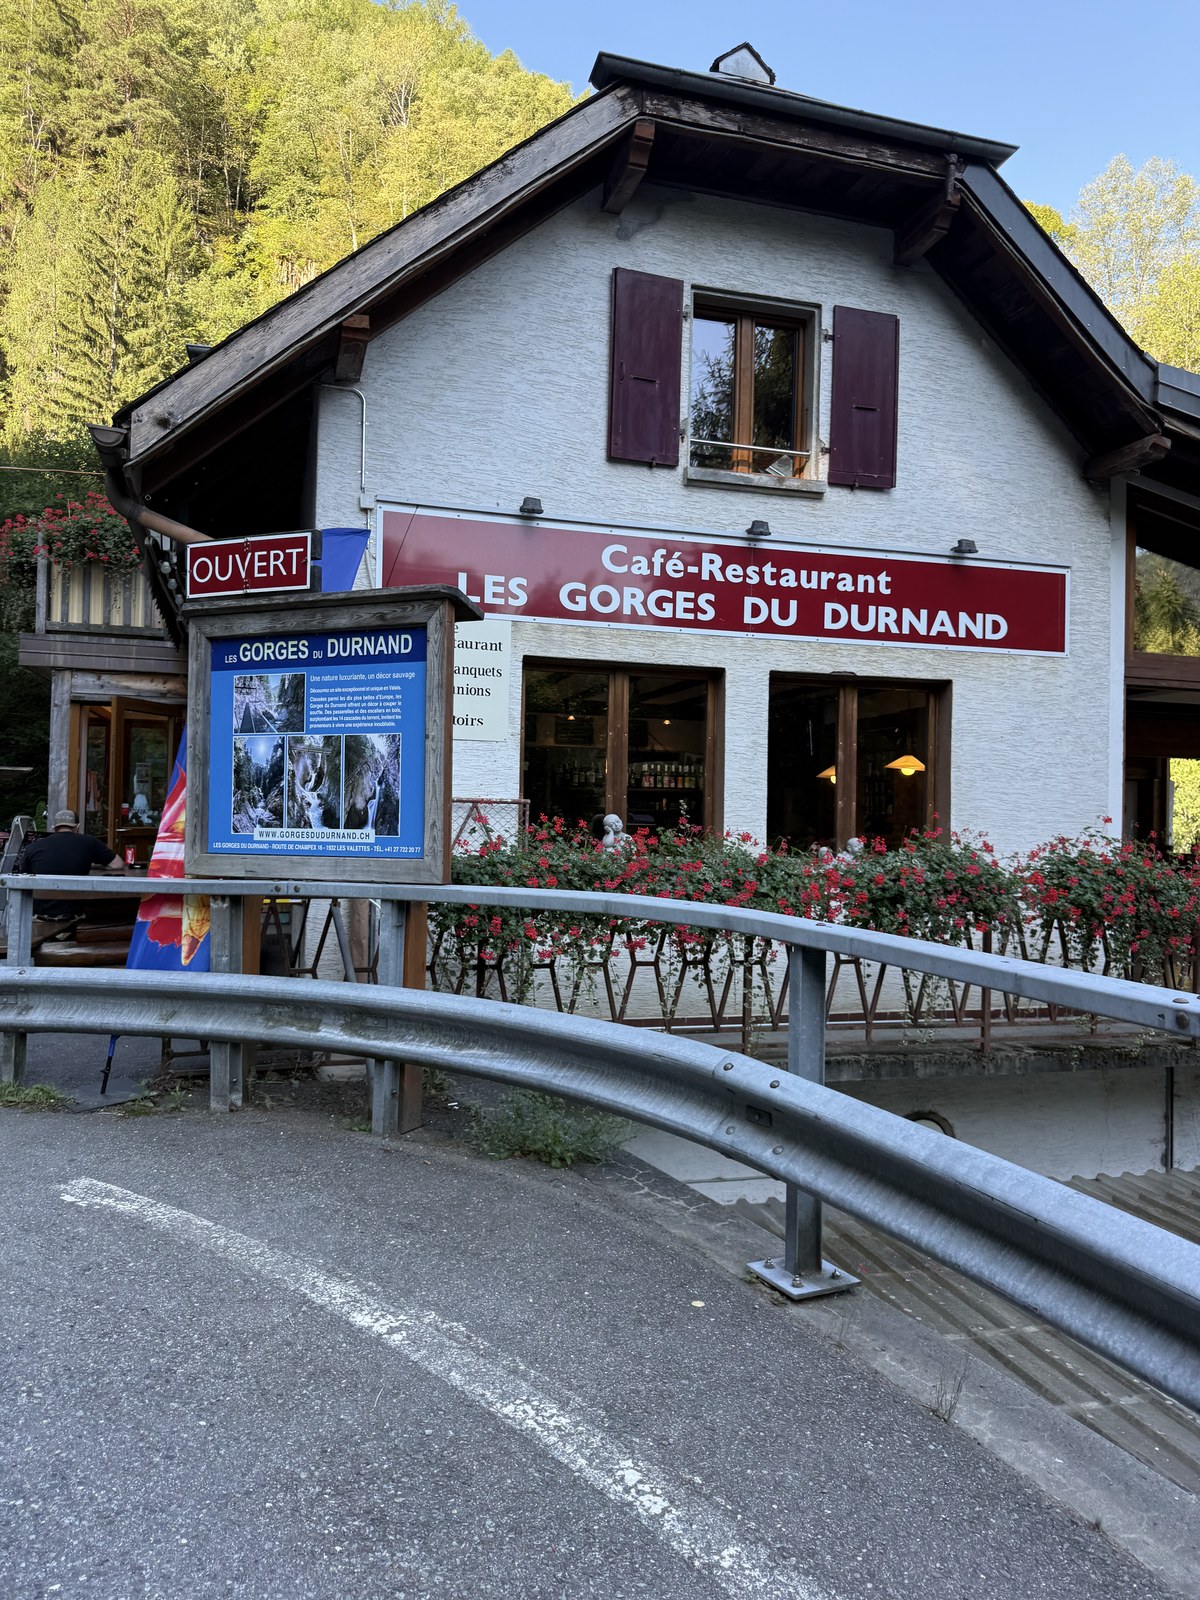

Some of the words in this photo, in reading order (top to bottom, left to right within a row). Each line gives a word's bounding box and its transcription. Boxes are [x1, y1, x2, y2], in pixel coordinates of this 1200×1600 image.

[192, 548, 304, 583] OUVERT
[601, 544, 892, 595] Café-Restaurant
[457, 572, 528, 607] LES
[559, 581, 716, 621] GORGES
[743, 596, 798, 627] DU
[824, 602, 1008, 640] DURNAND
[224, 655, 237, 664] LES
[239, 640, 309, 662] GORGES
[312, 650, 323, 659] DU
[327, 634, 413, 658] DURNAND
[339, 673, 367, 681] luxuriante,
[392, 672, 415, 680] sauvage
[258, 830, 370, 840] WWW.GORGESDUDURNAND.CH
